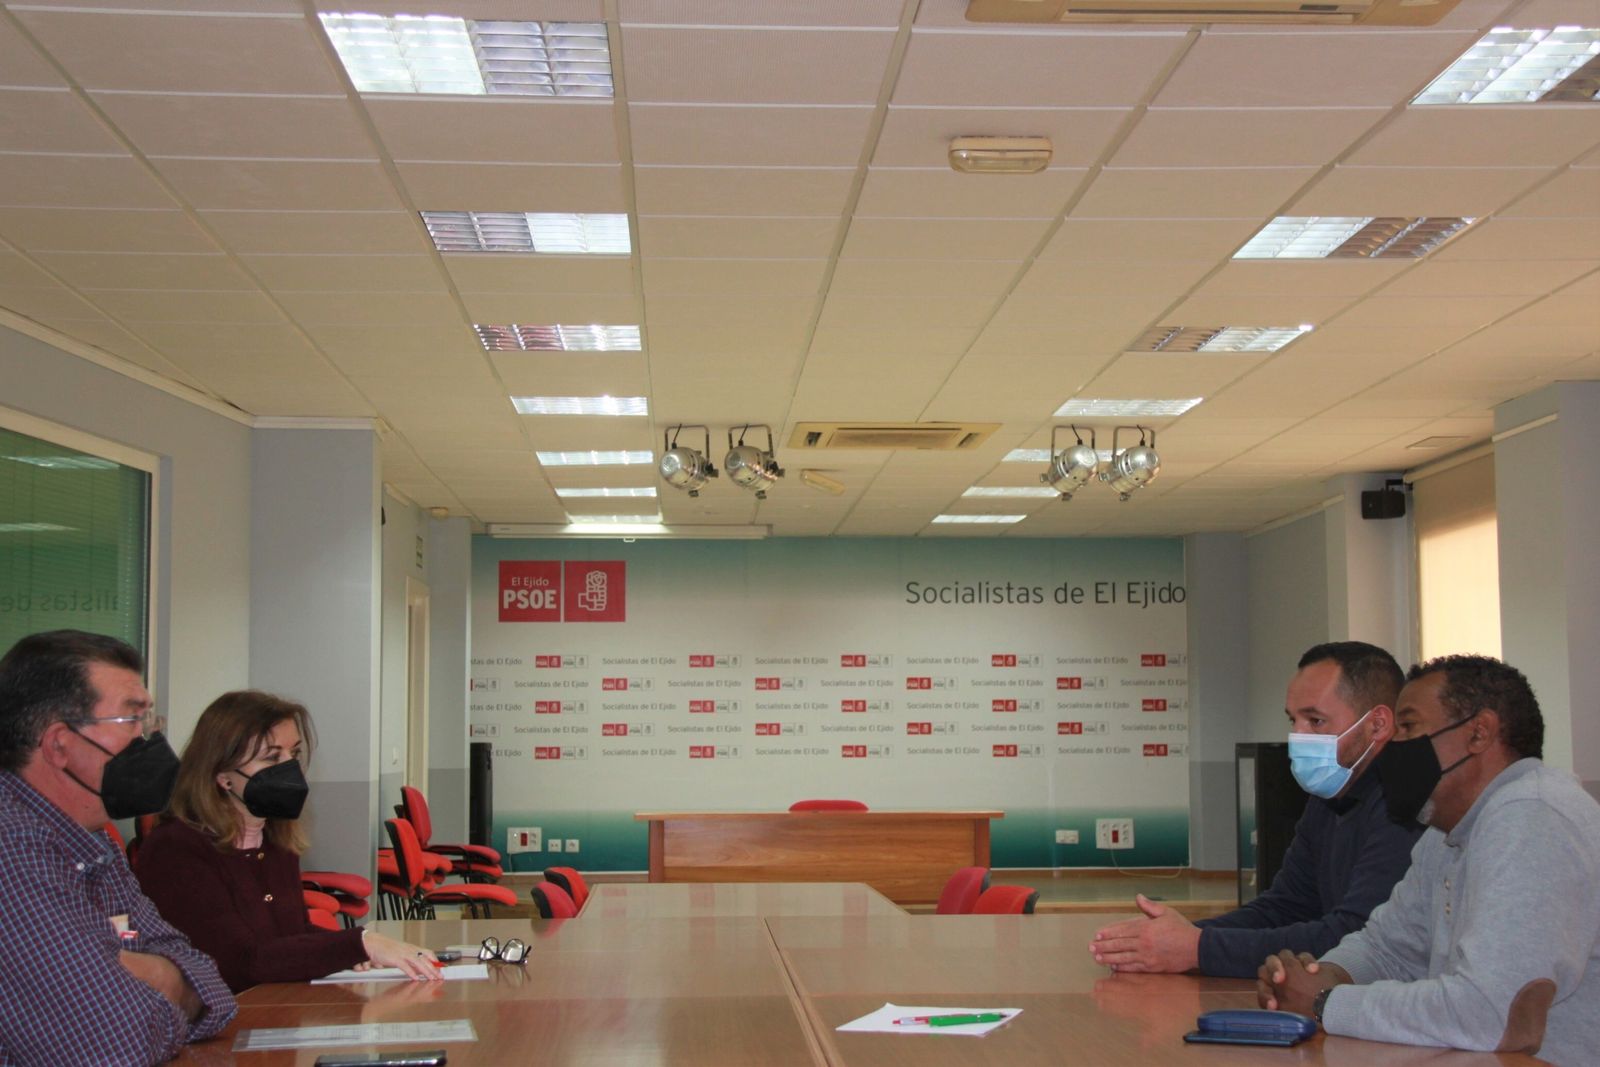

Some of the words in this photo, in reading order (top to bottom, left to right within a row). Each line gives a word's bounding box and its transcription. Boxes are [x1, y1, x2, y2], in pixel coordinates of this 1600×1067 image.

[511, 577, 520, 586] El
[524, 576, 549, 589] Ejido
[503, 589, 557, 609] PSOE
[906, 581, 1044, 604] Socialistas
[1054, 581, 1084, 604] de
[1095, 582, 1116, 604] El
[1127, 581, 1186, 609] Ejido
[495, 657, 503, 666] El
[650, 656, 658, 665] El
[802, 656, 810, 664] El
[953, 656, 961, 664] El
[1103, 655, 1110, 664] El
[562, 679, 570, 688] El
[715, 679, 723, 687] El
[868, 679, 875, 687] El
[1018, 678, 1025, 687] El
[495, 703, 503, 711] El
[650, 702, 658, 710] El
[803, 701, 810, 710] El
[953, 701, 961, 709] El
[1104, 701, 1111, 709] El
[562, 725, 570, 734] El
[715, 724, 723, 733] El
[868, 724, 875, 732] El
[1018, 723, 1025, 732] El
[495, 749, 503, 757] El
[650, 748, 658, 756] El
[803, 747, 810, 755] El
[954, 746, 962, 754] El
[1105, 746, 1112, 754] El
